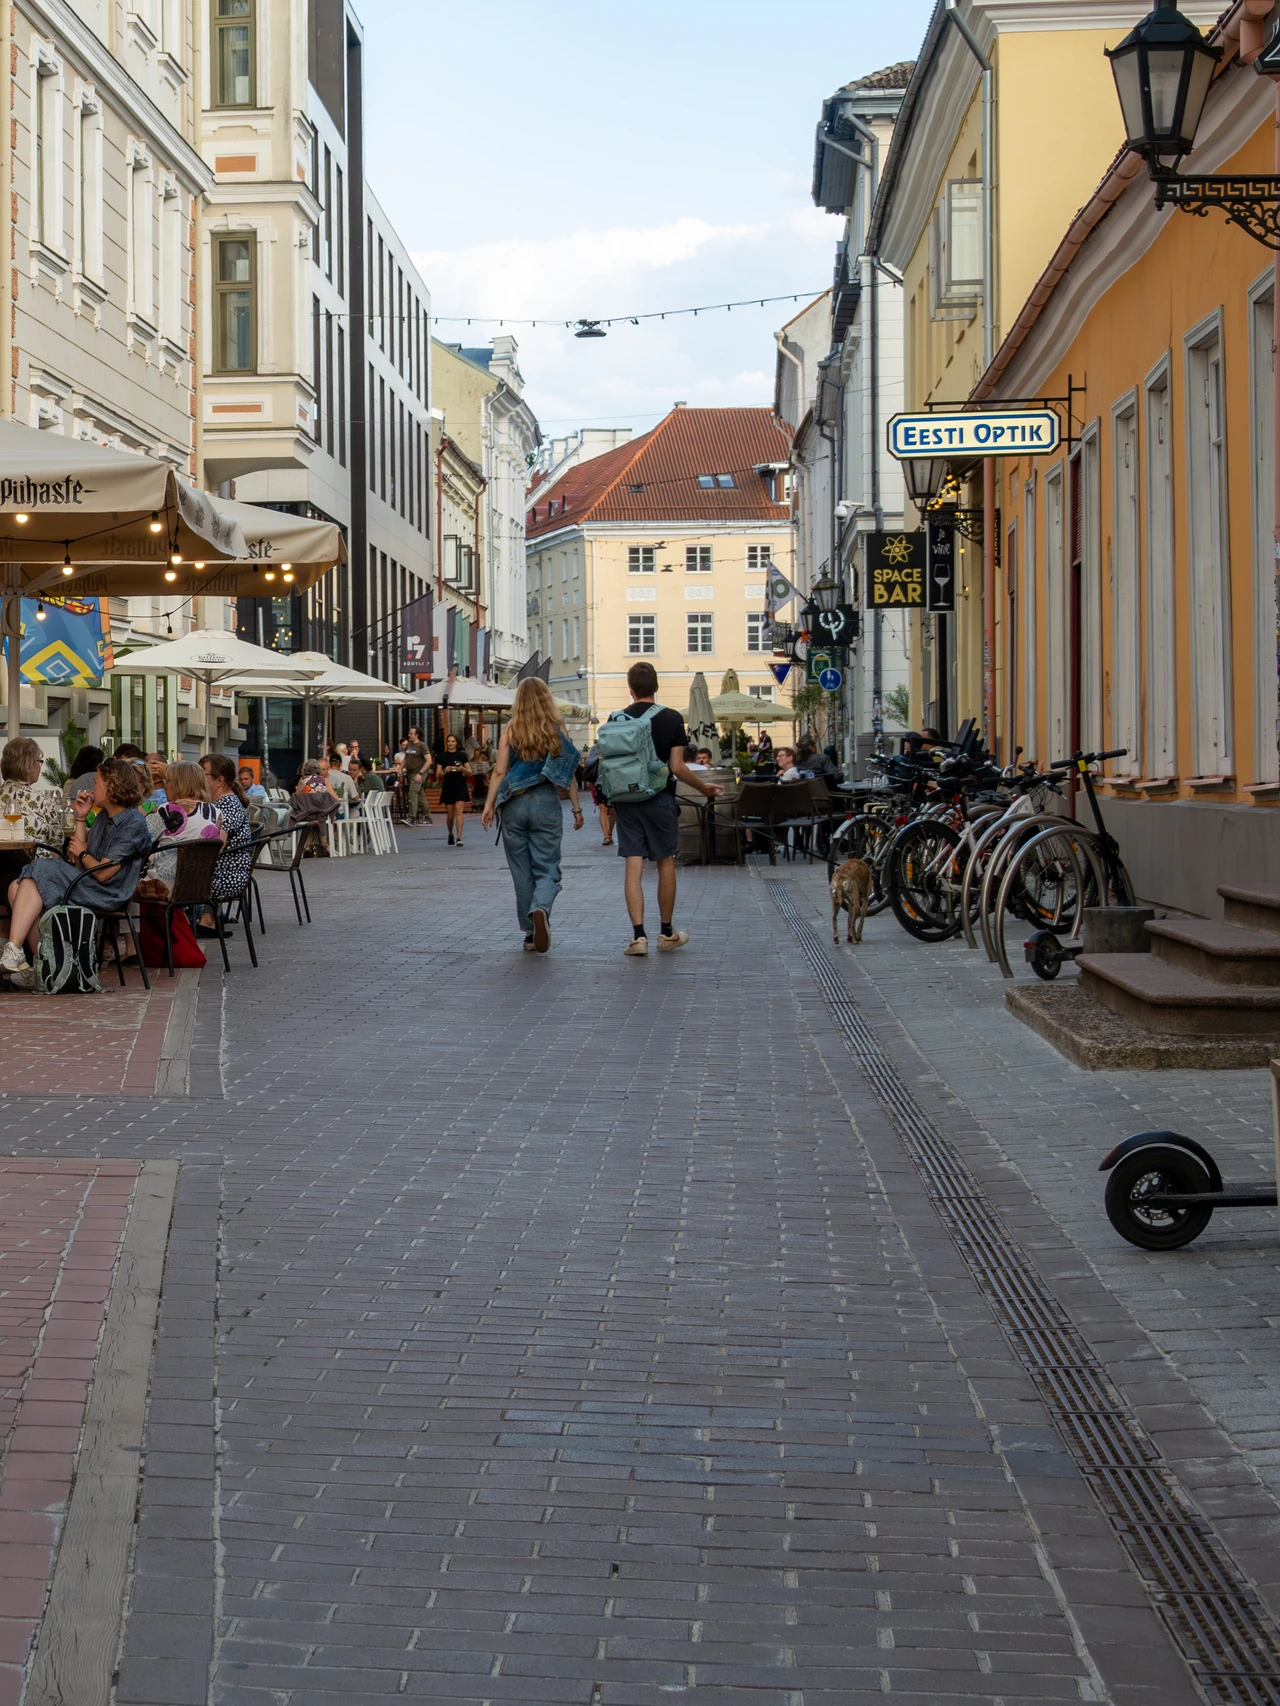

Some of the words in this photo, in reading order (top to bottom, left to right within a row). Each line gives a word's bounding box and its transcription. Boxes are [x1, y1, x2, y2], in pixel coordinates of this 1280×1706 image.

[903, 426, 964, 446] EESTI
[973, 423, 1043, 444] OPTIK
[873, 568, 922, 583] SPACE
[873, 583, 922, 604] BAR
